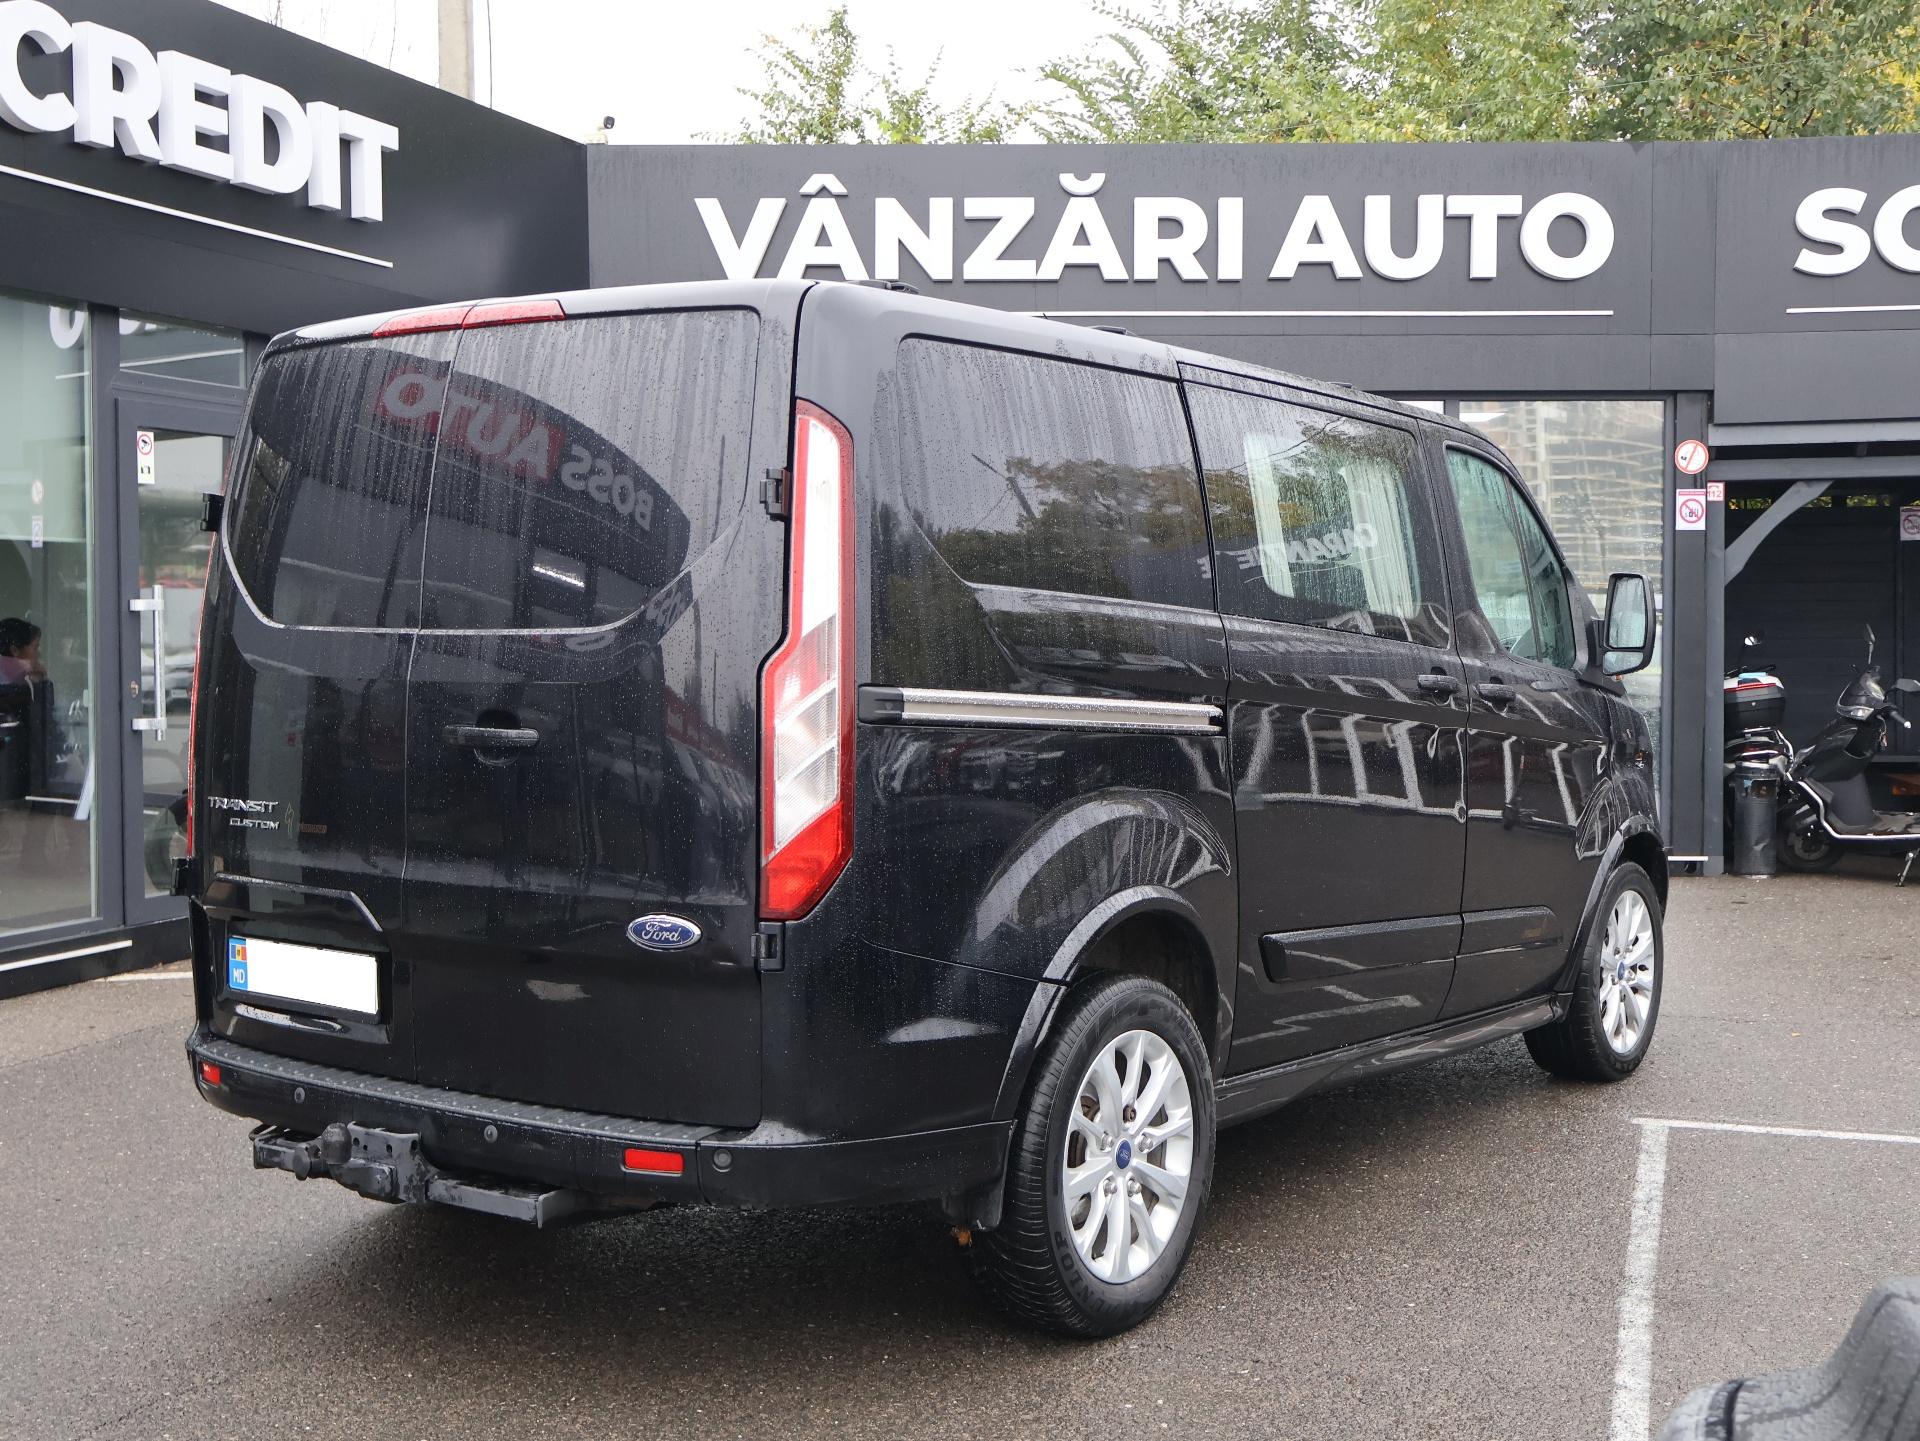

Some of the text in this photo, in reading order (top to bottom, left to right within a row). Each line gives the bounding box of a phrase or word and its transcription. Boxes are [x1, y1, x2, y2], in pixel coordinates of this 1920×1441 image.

[0, 0, 399, 222] CREDIT
[694, 173, 1615, 282] VÂNZĂRI AUTO
[207, 796, 279, 813] TRANSIT
[229, 817, 280, 830] CUSTOM
[641, 921, 682, 942] Ford
[233, 967, 246, 984] MD
